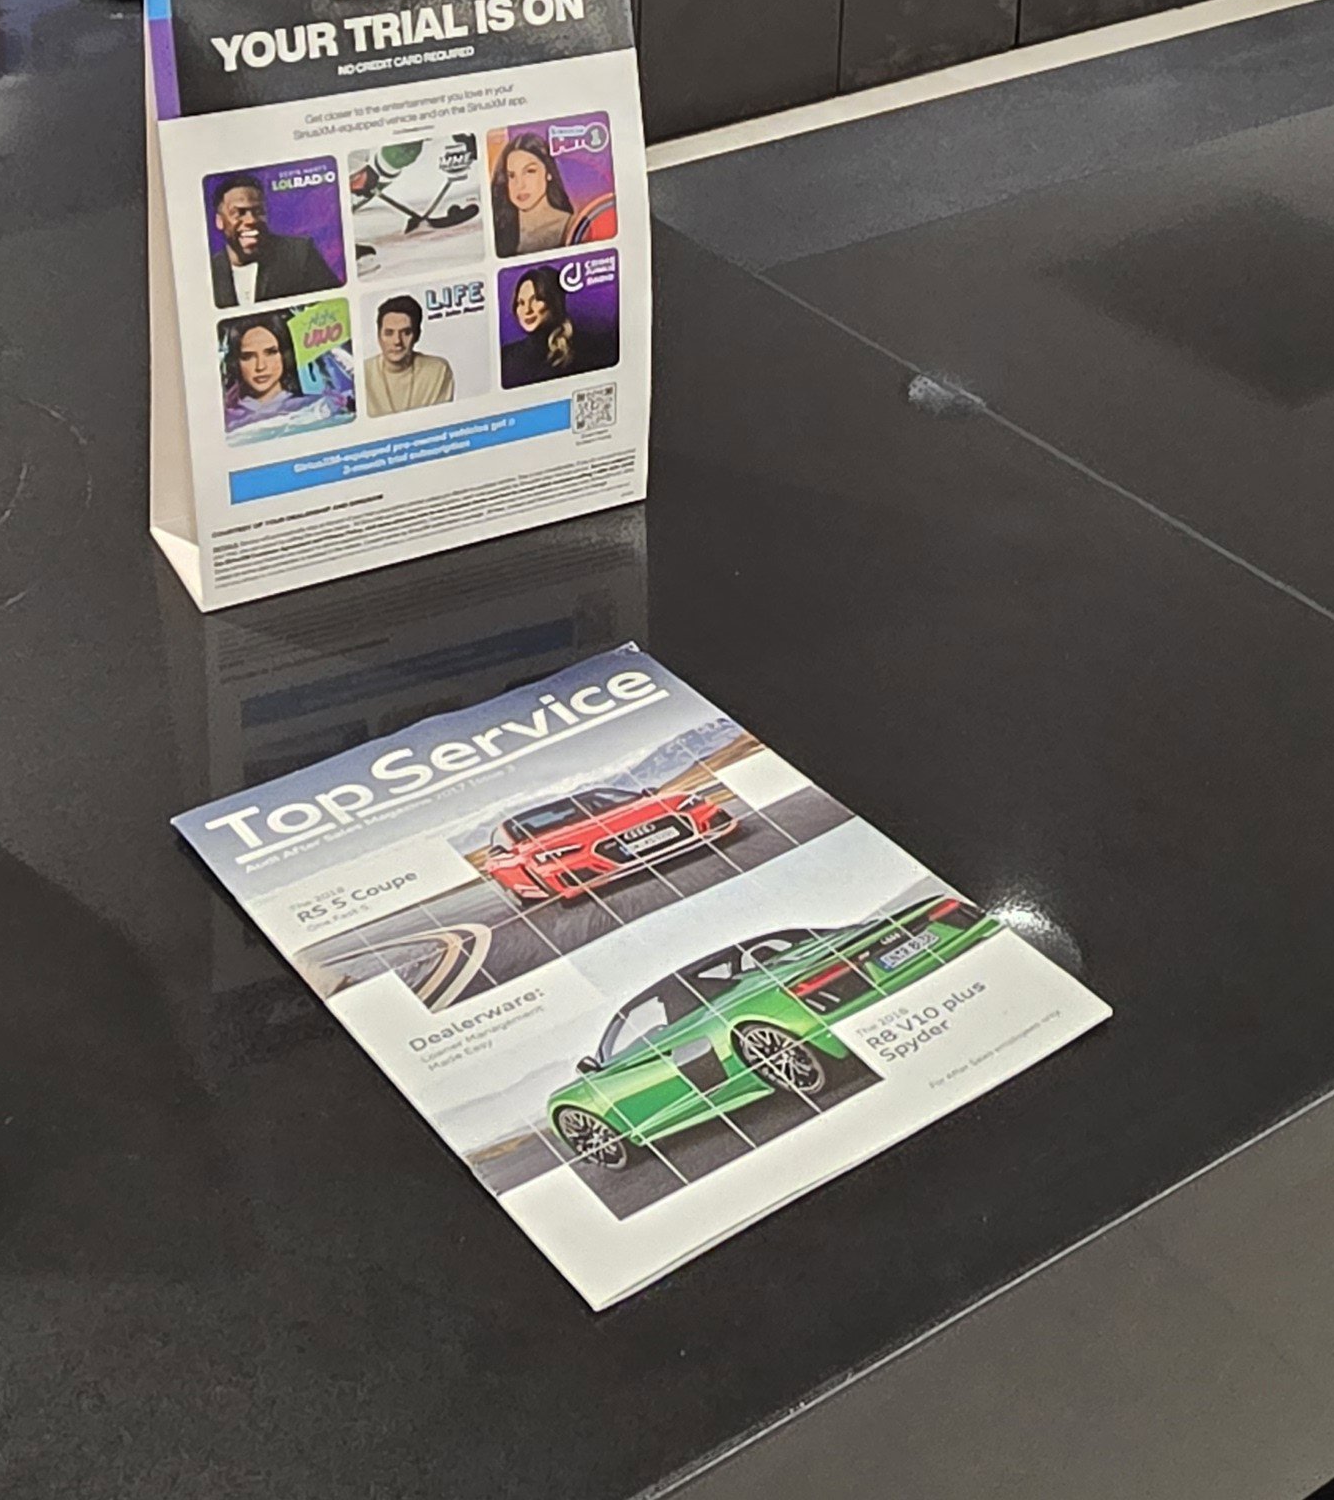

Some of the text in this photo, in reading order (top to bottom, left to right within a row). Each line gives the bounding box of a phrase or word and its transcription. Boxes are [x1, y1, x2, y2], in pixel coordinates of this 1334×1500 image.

[210, 22, 339, 72] YOUR
[343, 3, 469, 54] TRIAL
[337, 45, 475, 77] NO CREDIT CARD REQUIRED
[364, 105, 381, 116] the
[426, 281, 485, 311] LIFE
[303, 322, 343, 349] UNO
[244, 855, 281, 874] Audi
[282, 841, 322, 860] After
[323, 823, 363, 842] Sales
[296, 871, 418, 924] RS 5 Coupe
[407, 986, 546, 1053] Dealerware:
[864, 980, 987, 1051] R8 V10 plus
[878, 1017, 951, 1063] Spyder
